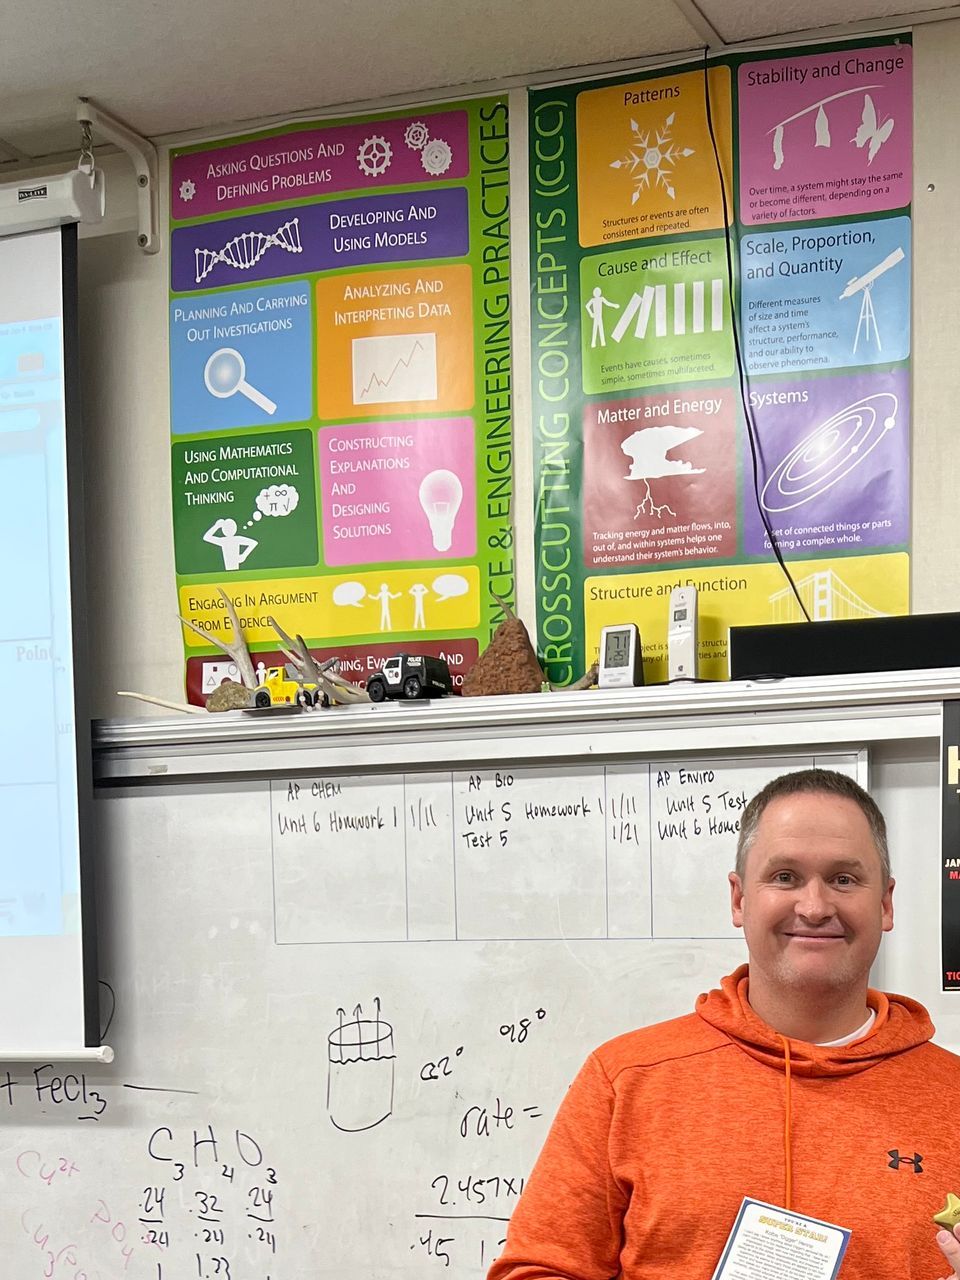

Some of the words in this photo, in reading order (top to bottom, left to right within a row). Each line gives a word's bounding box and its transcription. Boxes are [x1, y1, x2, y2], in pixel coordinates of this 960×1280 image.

[747, 66, 808, 86] Stability
[812, 63, 841, 79] and
[845, 56, 904, 75] Change
[624, 86, 680, 106] Patterns
[207, 160, 246, 179] ASKING
[250, 149, 313, 171] QUESTIONS
[317, 143, 344, 158] AND
[217, 182, 268, 201] DEFINING
[272, 170, 331, 190] PROBLEMS
[480, 103, 509, 285] PRACTICES
[330, 210, 404, 229] DEVELOPING
[408, 206, 436, 221] AND
[603, 216, 638, 228] Structures
[650, 210, 674, 220] events
[689, 206, 709, 215] often
[334, 237, 371, 252] USING
[374, 232, 427, 248] MODELS
[603, 228, 638, 239] consistent
[641, 225, 654, 234] and
[747, 238, 788, 256] Scale,
[792, 230, 876, 252] Proportion,
[598, 261, 638, 277] Cause
[641, 257, 668, 272] and
[672, 250, 712, 267] Effect
[747, 263, 774, 279] and
[779, 257, 843, 276] Quantity
[344, 282, 410, 300] ANALYZING
[414, 279, 443, 294] AND
[175, 306, 227, 322] PLANNING
[231, 301, 253, 317] AND
[256, 294, 307, 313] CARRYING
[334, 307, 414, 325] INTERPRETING
[418, 303, 451, 317] DATA
[536, 208, 570, 401] CONCEPTS
[187, 328, 209, 342] OUT
[213, 318, 292, 338] INVESTIGATIONS
[483, 296, 513, 519] ENGINEERING
[749, 389, 808, 409] Systems
[598, 407, 639, 424] Matter
[643, 403, 670, 418] and
[674, 398, 722, 419] Energy
[184, 449, 216, 464] USING
[219, 442, 292, 460] MATHEMATICS
[329, 435, 413, 452] CONSTRUCTING
[185, 471, 208, 485] AND
[211, 464, 298, 482] COMPUTATIONAL
[330, 458, 409, 474] EXPLANATIONS
[185, 491, 234, 506] THINKING
[332, 482, 356, 496] AND
[332, 502, 390, 518] DESIGNING
[333, 524, 391, 539] SOLUTIONS
[488, 526, 513, 549] &
[539, 412, 573, 687] CROSSCUTTING
[246, 594, 255, 606] IN
[260, 592, 318, 605] ARGUMENT
[591, 587, 652, 600] Structure
[468, 775, 481, 792] AP
[657, 770, 670, 788] AP
[288, 782, 300, 801] AP
[312, 781, 342, 799] CHEM
[525, 796, 591, 819] Homework
[313, 811, 320, 832] 6
[462, 831, 492, 848] Test
